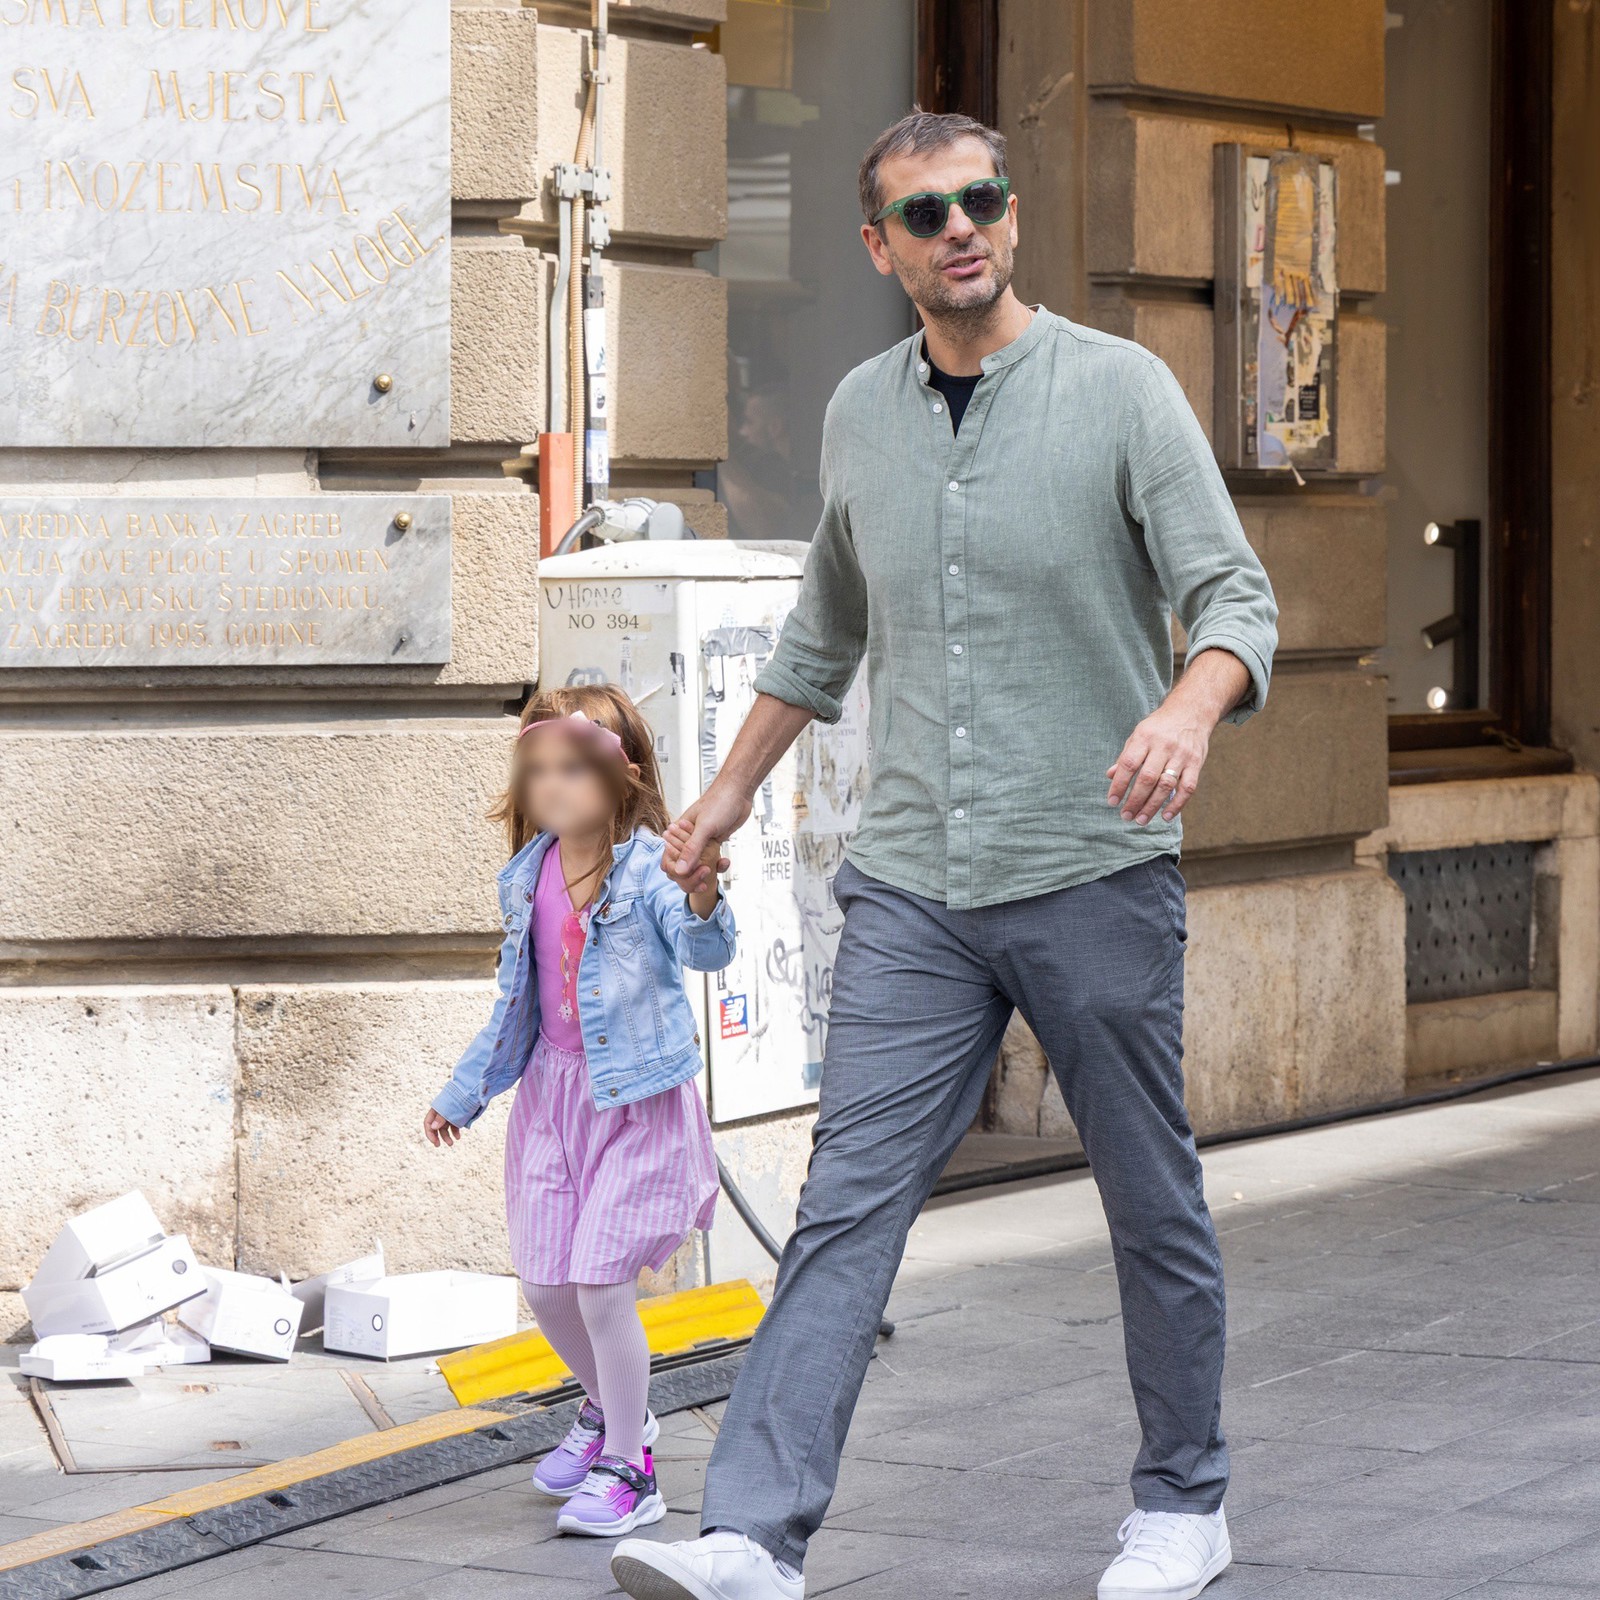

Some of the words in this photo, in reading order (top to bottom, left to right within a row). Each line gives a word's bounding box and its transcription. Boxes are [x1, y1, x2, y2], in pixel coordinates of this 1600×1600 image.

[8, 66, 95, 120] SVA
[144, 69, 349, 124] MJESTA
[44, 160, 359, 216] INOZEMSTVA.
[36, 277, 269, 348] BURZOVNE
[275, 204, 446, 324] NALOGE.
[126, 512, 220, 540] BANKA
[236, 512, 342, 539] ZAGREB
[80, 550, 135, 576] OVE
[248, 549, 264, 575] U
[278, 549, 391, 575] SPOMEN
[0, 586, 43, 613] VU
[58, 586, 203, 613] HRVATSKU
[218, 582, 386, 612] ŠTEDIONICU.
[568, 614, 595, 629] NO
[607, 614, 639, 629] 394
[8, 623, 135, 649] ZAGREBU
[224, 622, 323, 648] GODINE
[762, 840, 790, 859] WAS
[762, 862, 791, 880] HERE
